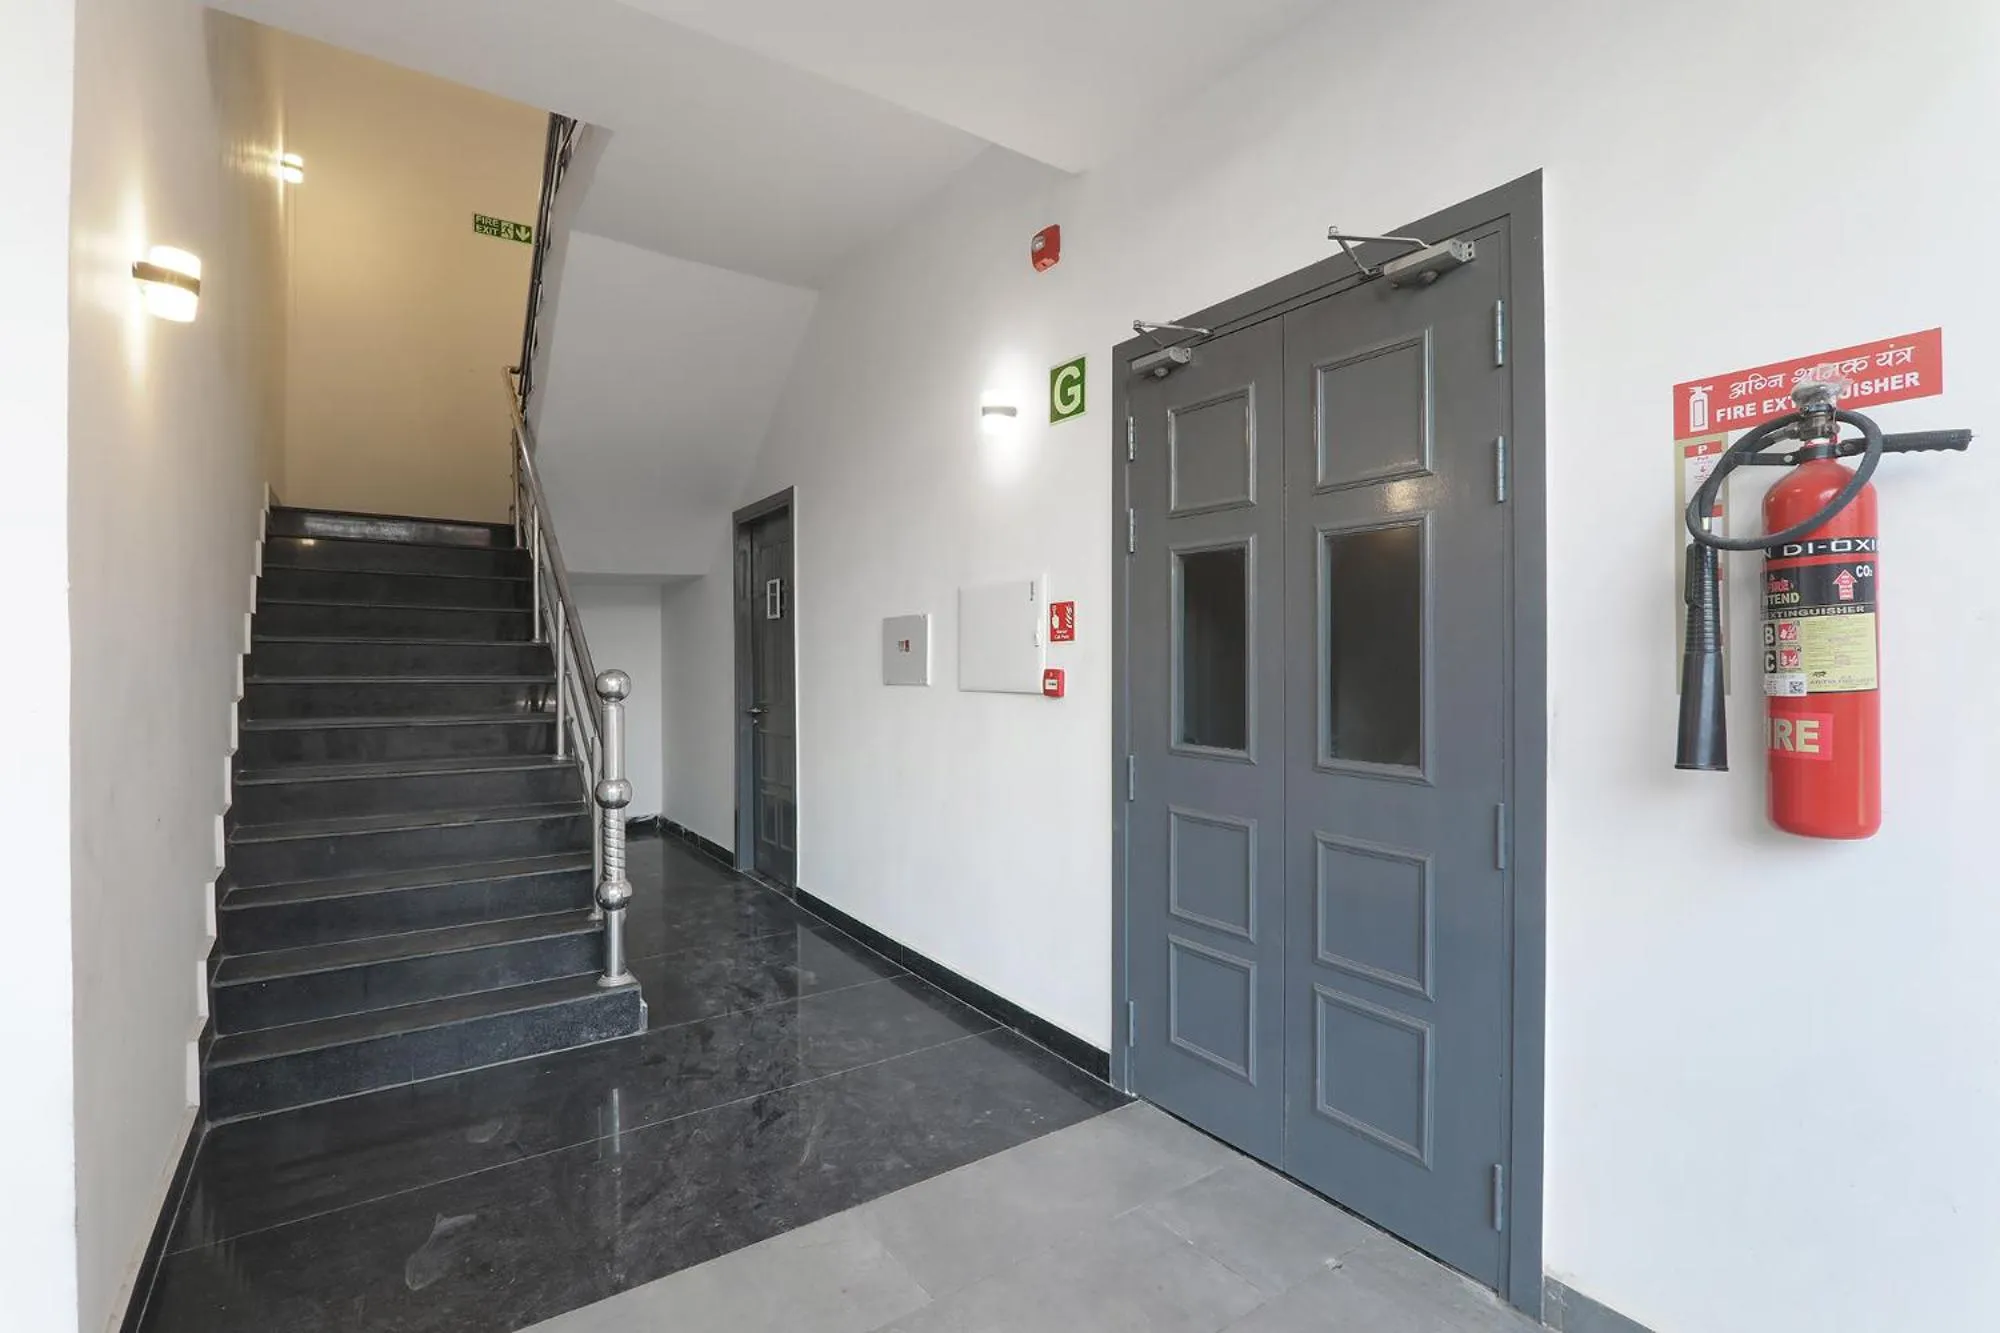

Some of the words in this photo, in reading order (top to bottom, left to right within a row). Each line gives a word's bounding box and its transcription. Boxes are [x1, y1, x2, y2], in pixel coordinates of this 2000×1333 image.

[475, 215, 499, 226] FIRE
[476, 224, 498, 236] EXIT
[1728, 372, 1786, 400] अग्नि
[1876, 343, 1917, 367] यंत्र
[1054, 365, 1081, 415] G
[1715, 402, 1757, 423] FIRE
[1762, 371, 1921, 415] EXTUISHER
[1783, 539, 1877, 557] DI-OXI
[1768, 605, 1865, 618] XTINGUISHER
[1766, 717, 1820, 754] IRE
